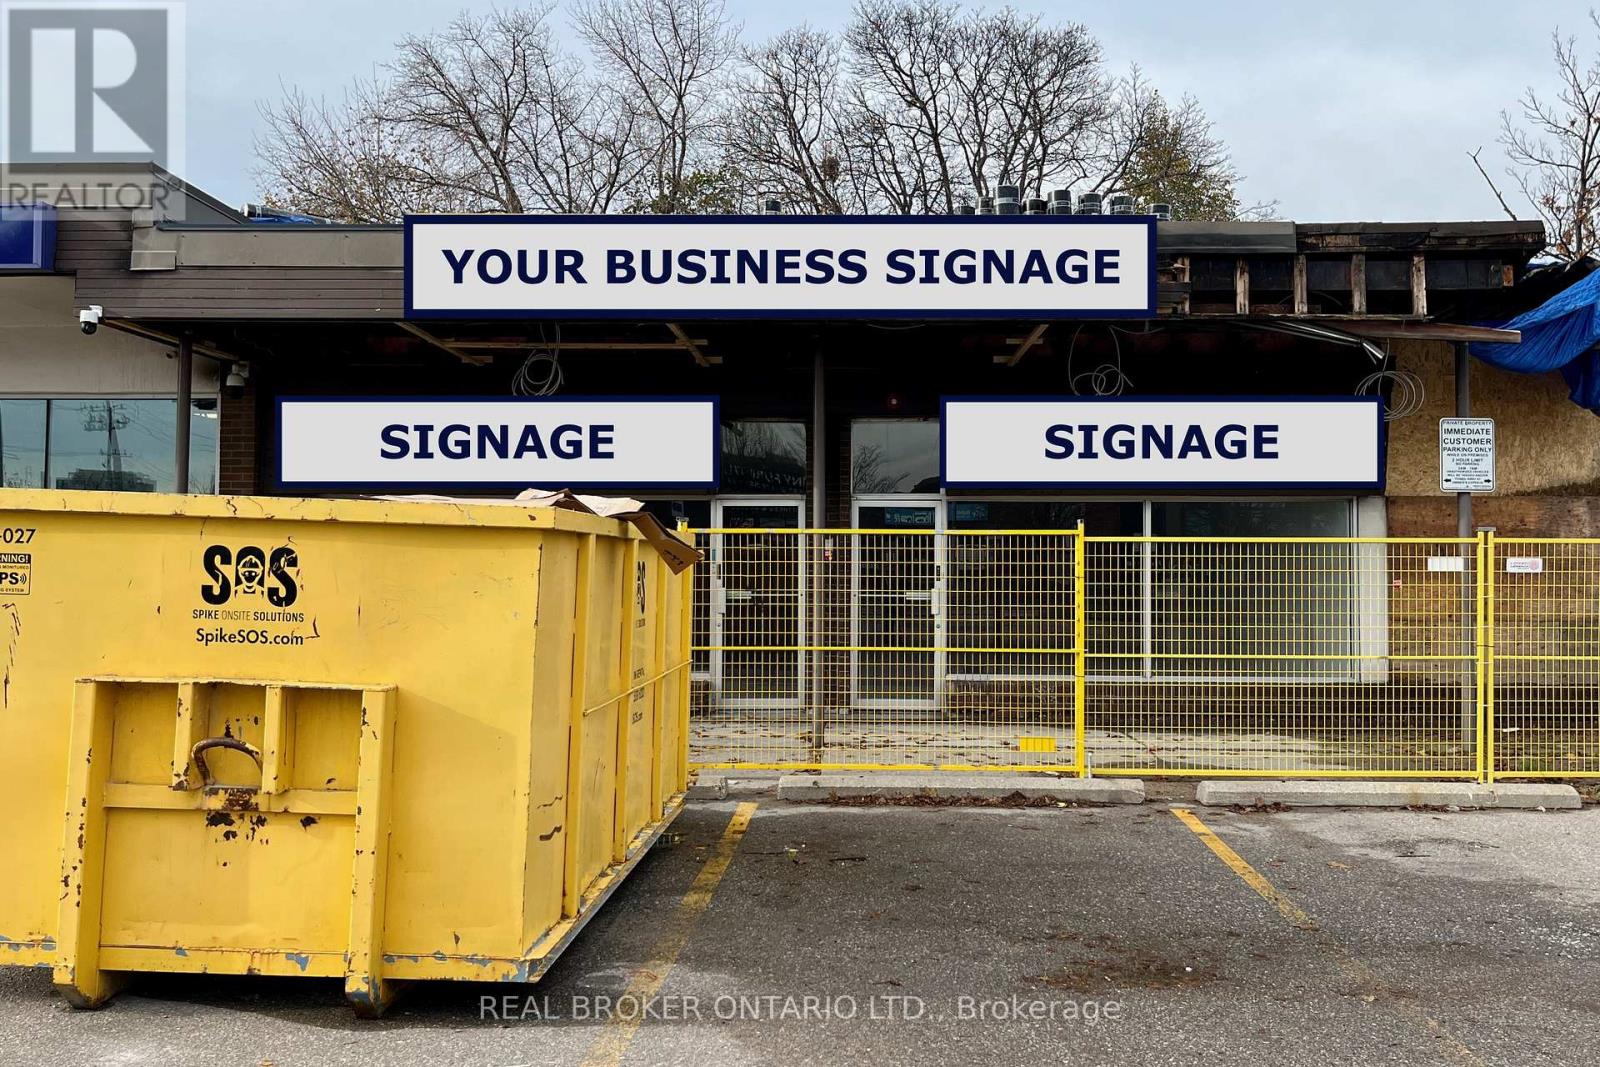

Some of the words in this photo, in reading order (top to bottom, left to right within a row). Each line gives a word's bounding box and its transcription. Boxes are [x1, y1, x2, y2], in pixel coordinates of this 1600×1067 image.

[442, 249, 587, 285] YOUR
[607, 249, 867, 285] BUSINESS
[886, 249, 1120, 285] SIGNAGE
[381, 424, 615, 460] SIGNAGE
[1045, 424, 1279, 460] SIGNAGE
[1443, 437, 1492, 445] CUSTOMER
[0, 554, 29, 563] NING!
[192, 608, 220, 620] SPIKE
[221, 610, 251, 621] ONSITE
[253, 611, 305, 622] SOLUTIONS
[195, 627, 304, 646] SpikeSOS.com
